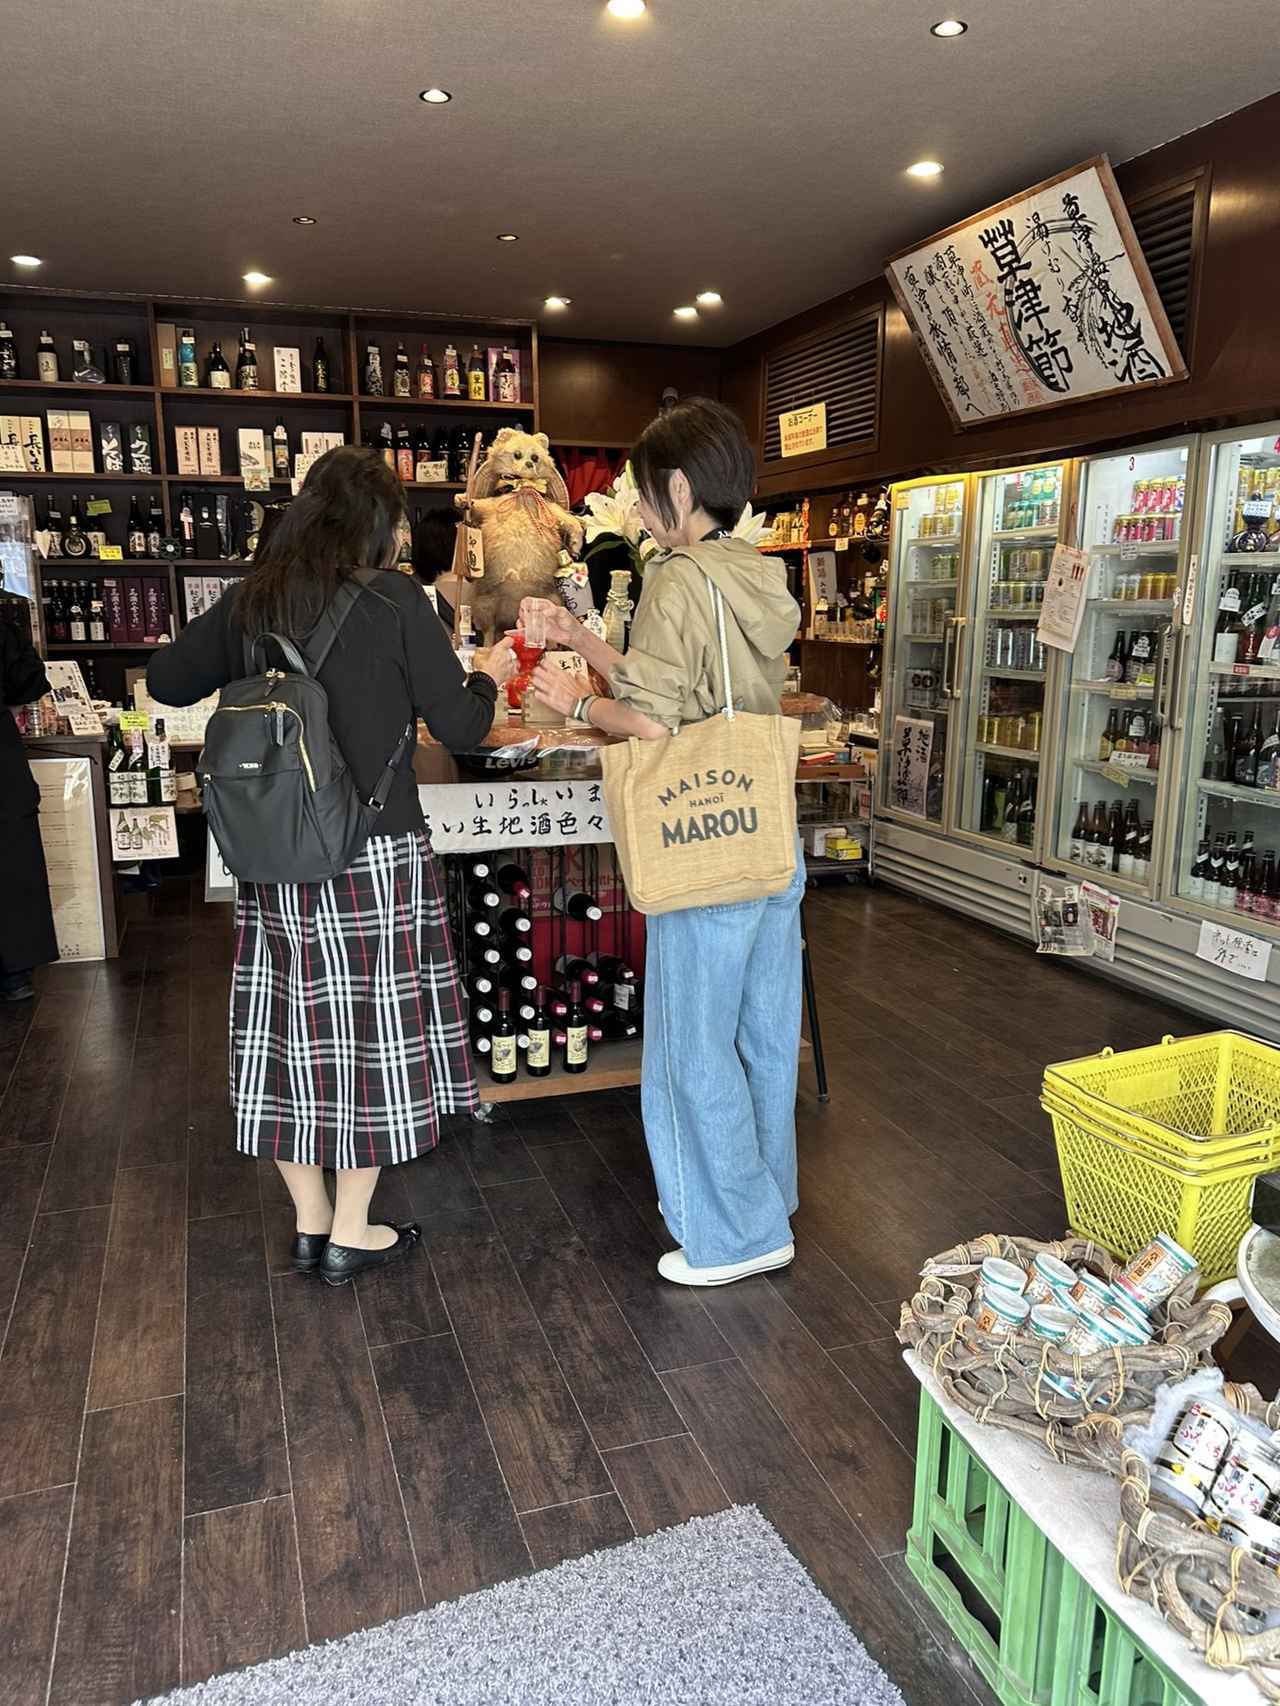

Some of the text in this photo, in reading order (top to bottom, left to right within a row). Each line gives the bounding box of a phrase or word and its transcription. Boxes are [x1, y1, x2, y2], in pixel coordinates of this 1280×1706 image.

[1129, 456, 1136, 471] 3
[658, 769, 754, 807] MAISON
[661, 807, 758, 848] MAROU
